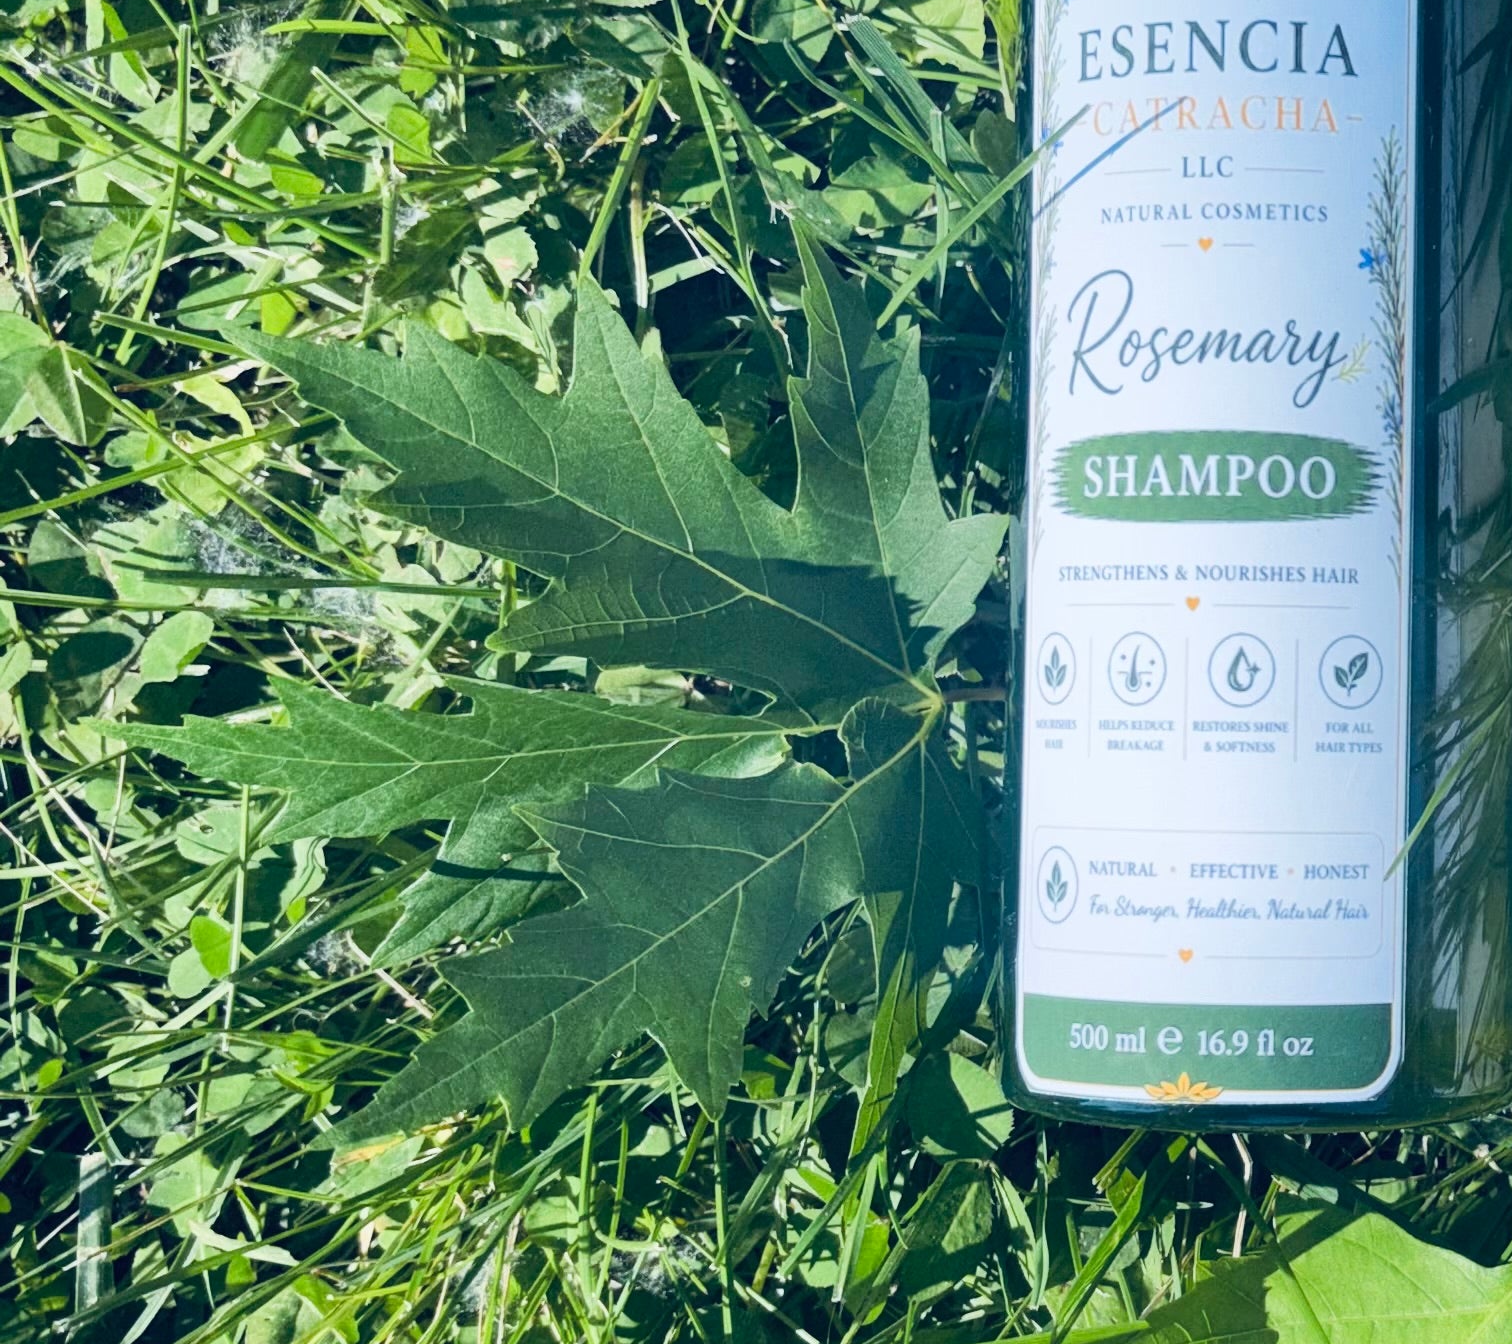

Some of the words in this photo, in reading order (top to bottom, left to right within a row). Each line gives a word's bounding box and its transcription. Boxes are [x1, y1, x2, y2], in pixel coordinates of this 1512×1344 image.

[1078, 18, 1358, 82] ESENCIA
[1182, 156, 1234, 178] LLC
[1101, 203, 1192, 224] NATURAL
[1202, 203, 1328, 223] COSMETICS
[1067, 269, 1346, 408] Rosemary
[1083, 454, 1336, 499] SHAMPOO
[1059, 564, 1168, 582] STRENGTHENS
[1176, 566, 1188, 582] &
[1196, 564, 1306, 583] NOURISHES
[1312, 567, 1359, 584] HAIR
[1099, 719, 1128, 731] HELPS
[1131, 720, 1174, 731] REDUCE
[1192, 720, 1250, 733] RESTORES
[1253, 721, 1289, 733] SHINE
[1325, 722, 1348, 733] FOR
[1350, 722, 1374, 733] ALL
[1107, 740, 1164, 751] BREAKAGE
[1204, 742, 1211, 752] &
[1216, 742, 1275, 753] SOFTNESS
[1315, 742, 1345, 753] HAIR
[1347, 742, 1383, 754] TYPES
[1089, 861, 1158, 877] NATURAL
[1190, 863, 1278, 879] EFFECTIVE
[1303, 864, 1370, 880] HONEST
[1089, 894, 1110, 916] For
[1267, 899, 1330, 921] Natural
[1335, 900, 1370, 920] Hair
[1069, 1022, 1108, 1051] 500
[1115, 1027, 1146, 1053] ml
[1198, 1030, 1249, 1056] 16.9
[1257, 1029, 1275, 1056] fl
[1283, 1034, 1314, 1056] oz
